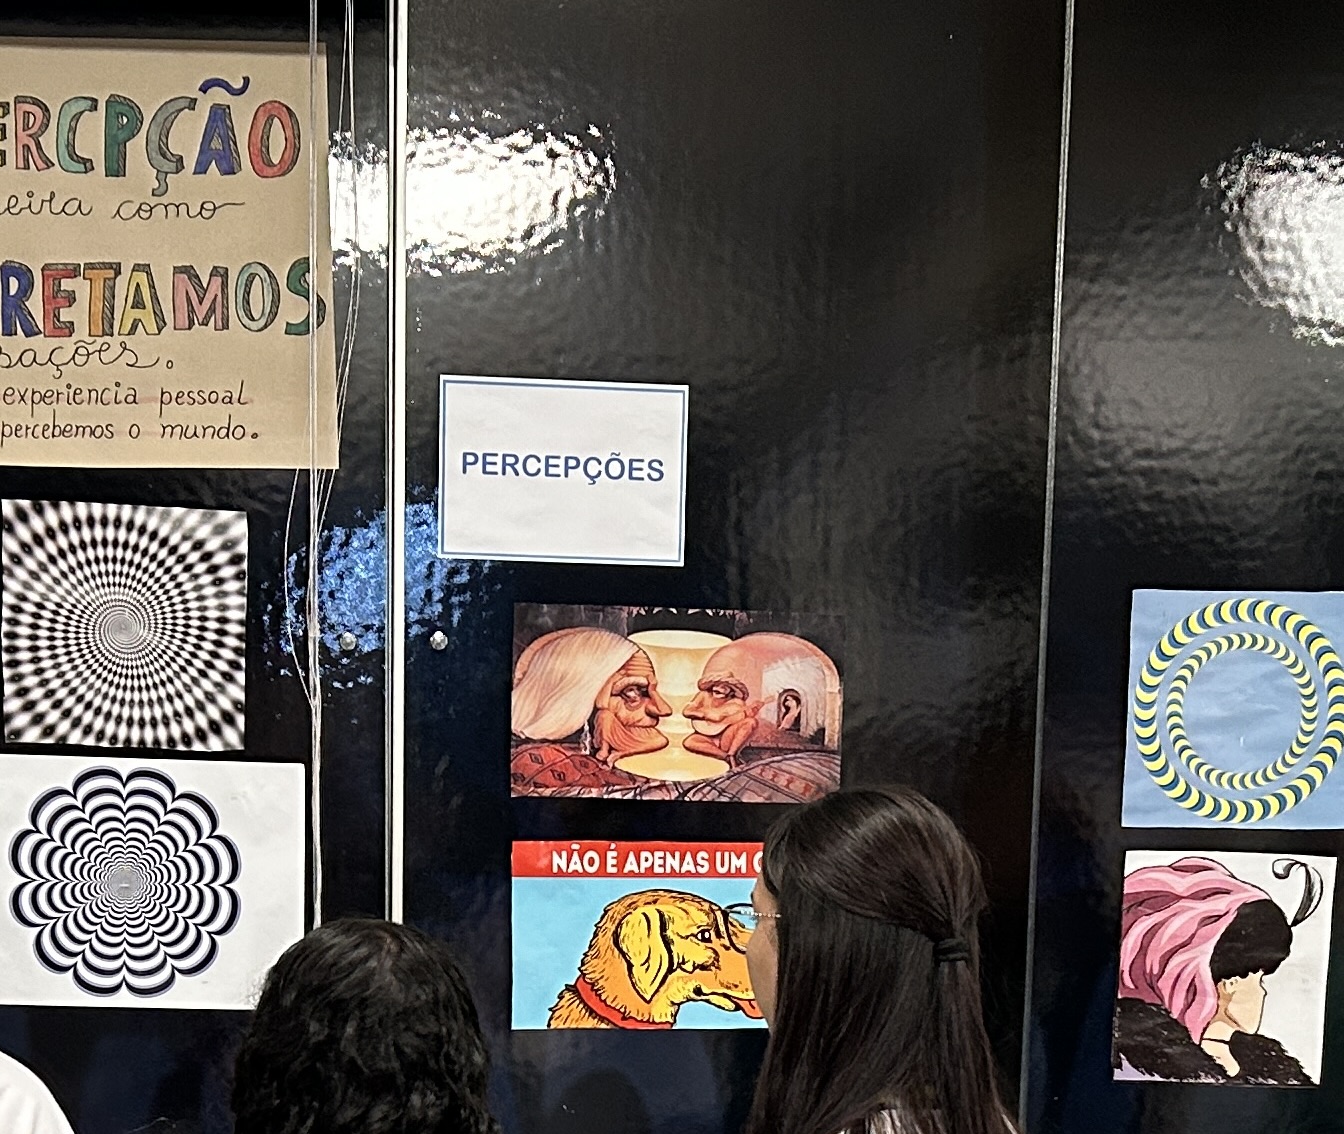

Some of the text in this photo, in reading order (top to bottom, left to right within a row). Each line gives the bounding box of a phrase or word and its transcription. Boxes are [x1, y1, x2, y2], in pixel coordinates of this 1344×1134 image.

[111, 194, 247, 222] como
[2, 381, 140, 418] experiencia
[158, 379, 250, 418] pessoal
[1, 409, 115, 448] percebemos
[128, 423, 141, 439] o
[160, 413, 260, 441] mundo.
[461, 451, 666, 486] PERCEPÇÕES
[551, 843, 601, 874] NÃO
[605, 842, 618, 874] É
[622, 850, 710, 875] APENAS
[714, 850, 748, 874] UM
